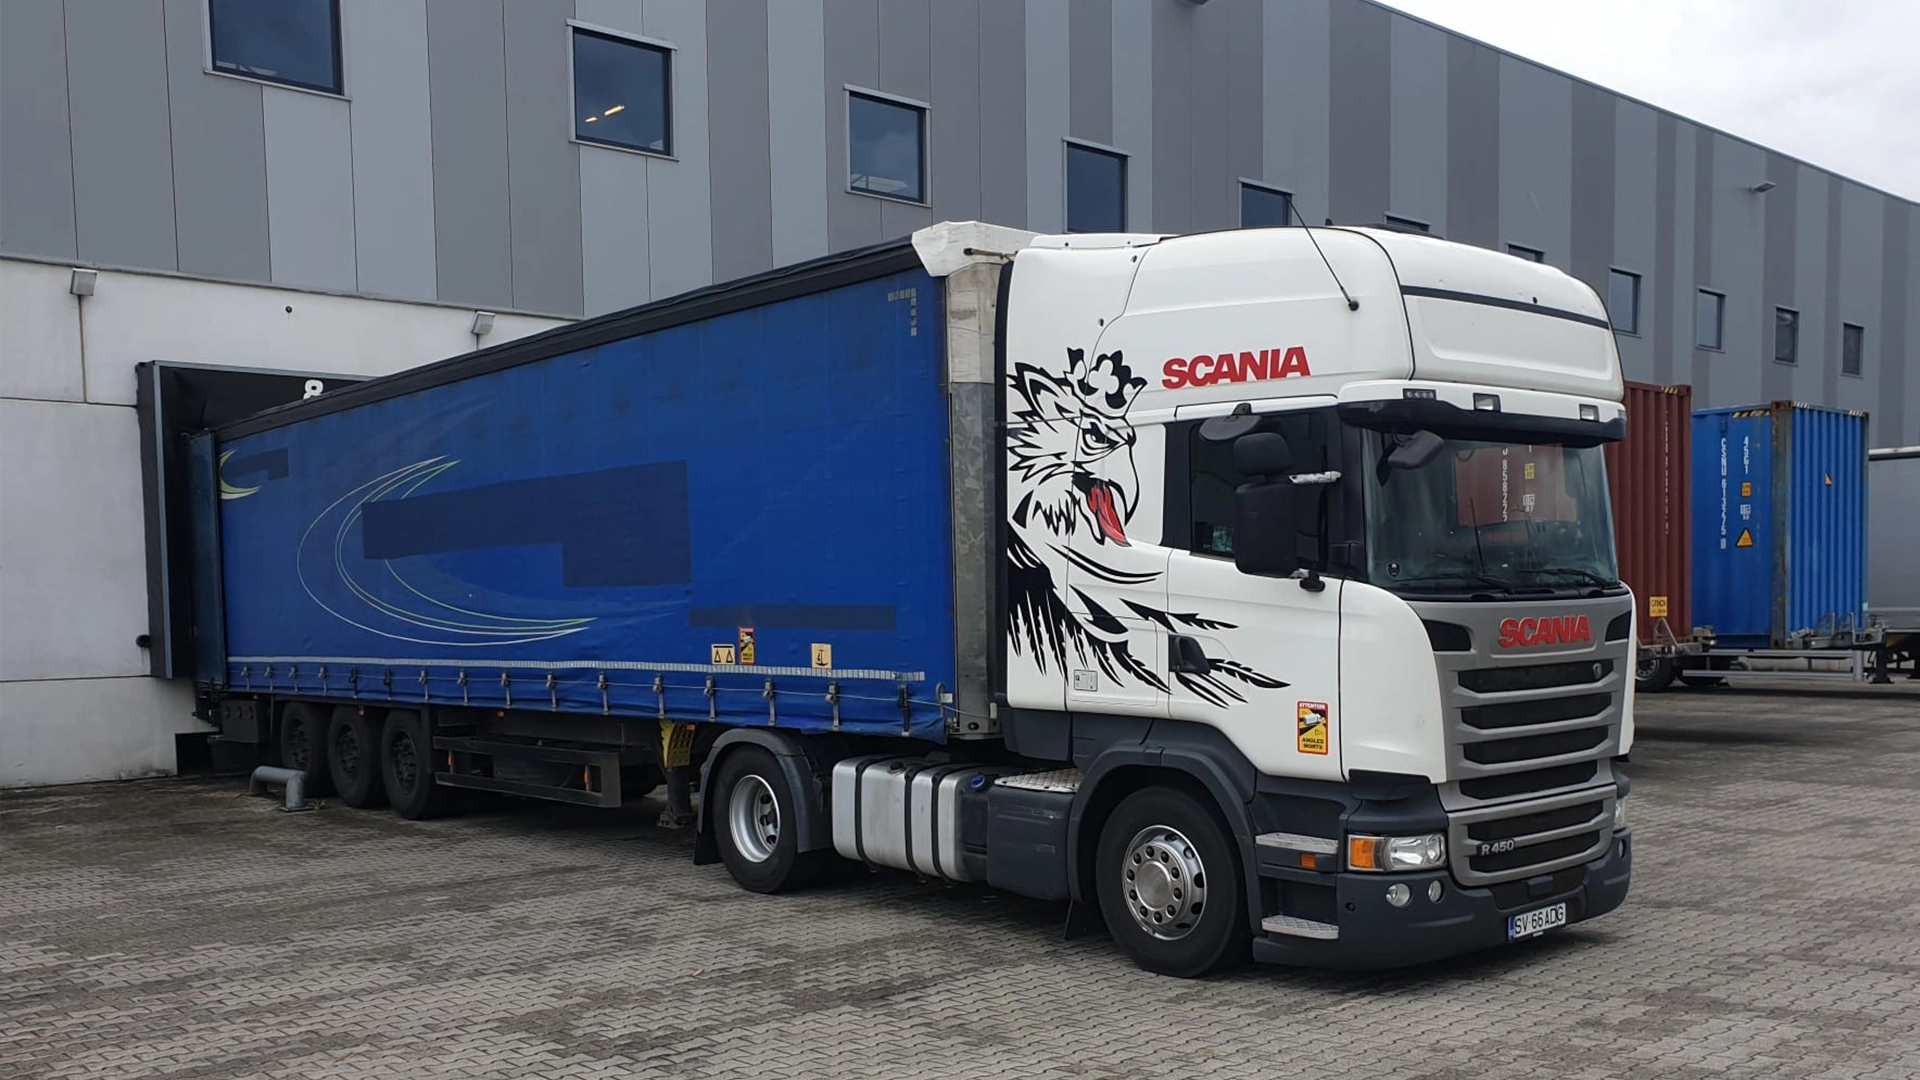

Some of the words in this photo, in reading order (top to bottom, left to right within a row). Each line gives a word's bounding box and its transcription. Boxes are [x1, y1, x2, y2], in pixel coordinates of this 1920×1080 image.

[1162, 346, 1311, 389] SCANIA
[1498, 614, 1590, 649] SCANIA
[1481, 843, 1491, 856] R
[1491, 839, 1515, 853] 450
